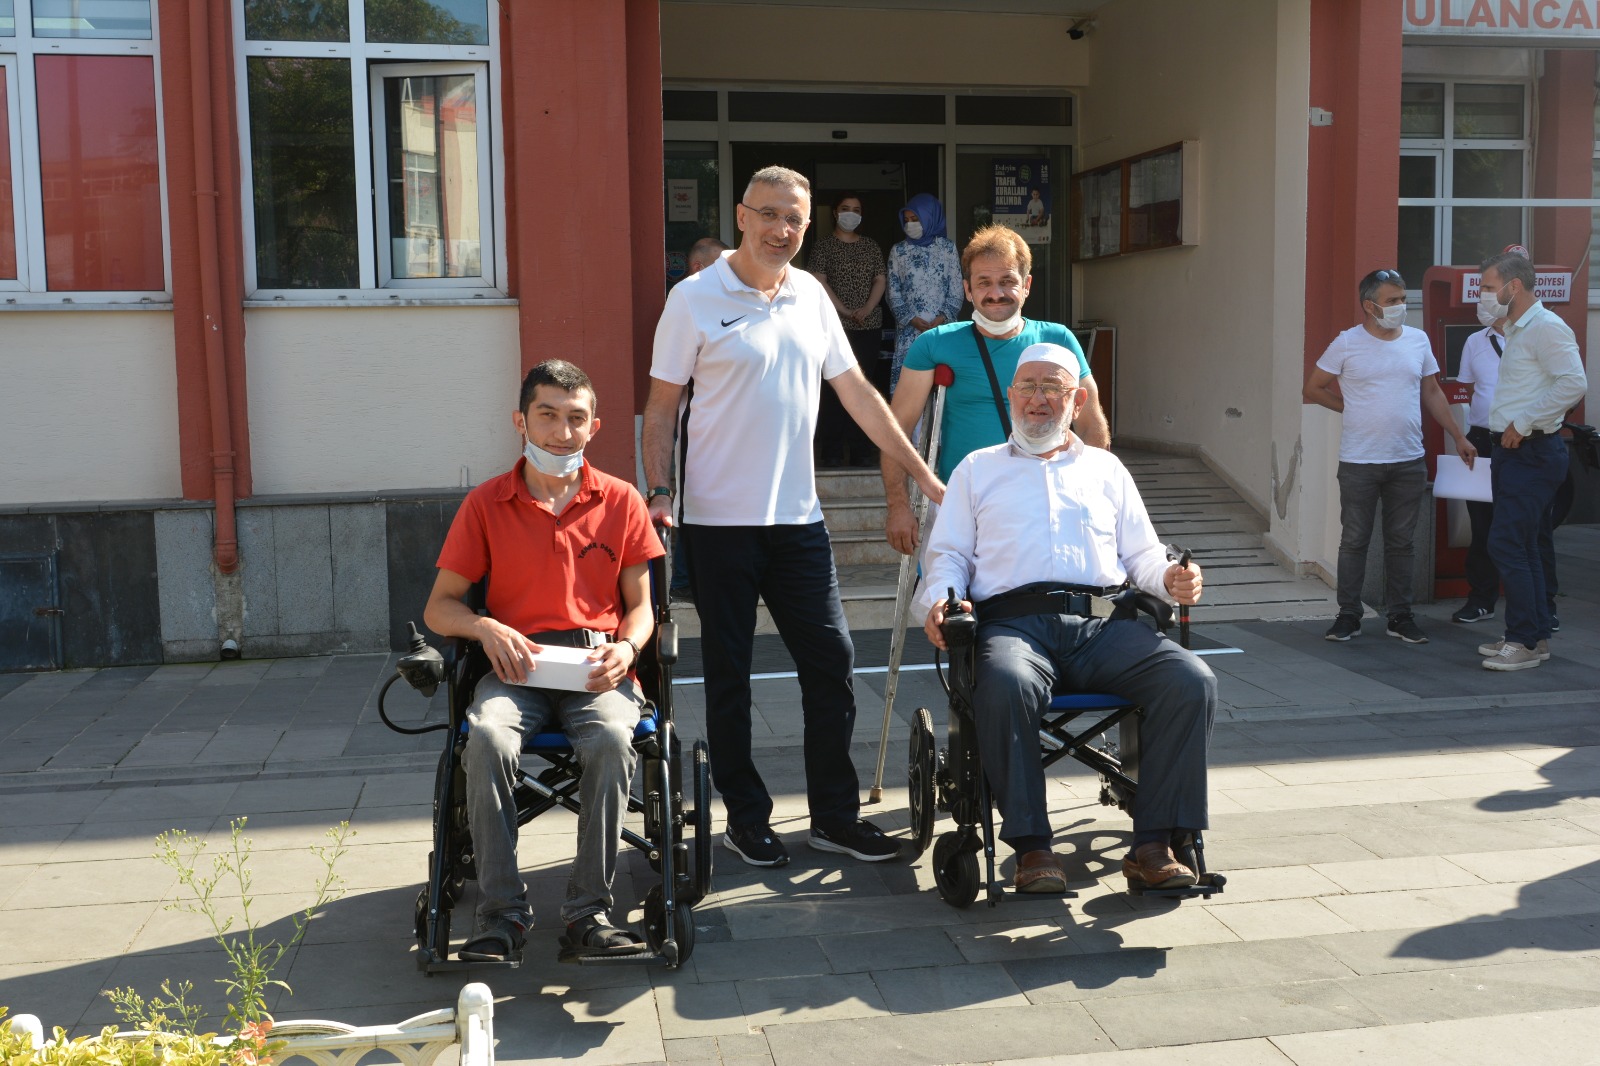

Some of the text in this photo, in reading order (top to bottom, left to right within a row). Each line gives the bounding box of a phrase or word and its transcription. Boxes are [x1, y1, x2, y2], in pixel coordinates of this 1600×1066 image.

[1406, 0, 1600, 29] ULANCA
[1534, 276, 1565, 286] EDİYESİ
[1534, 289, 1565, 298] OKTASI
